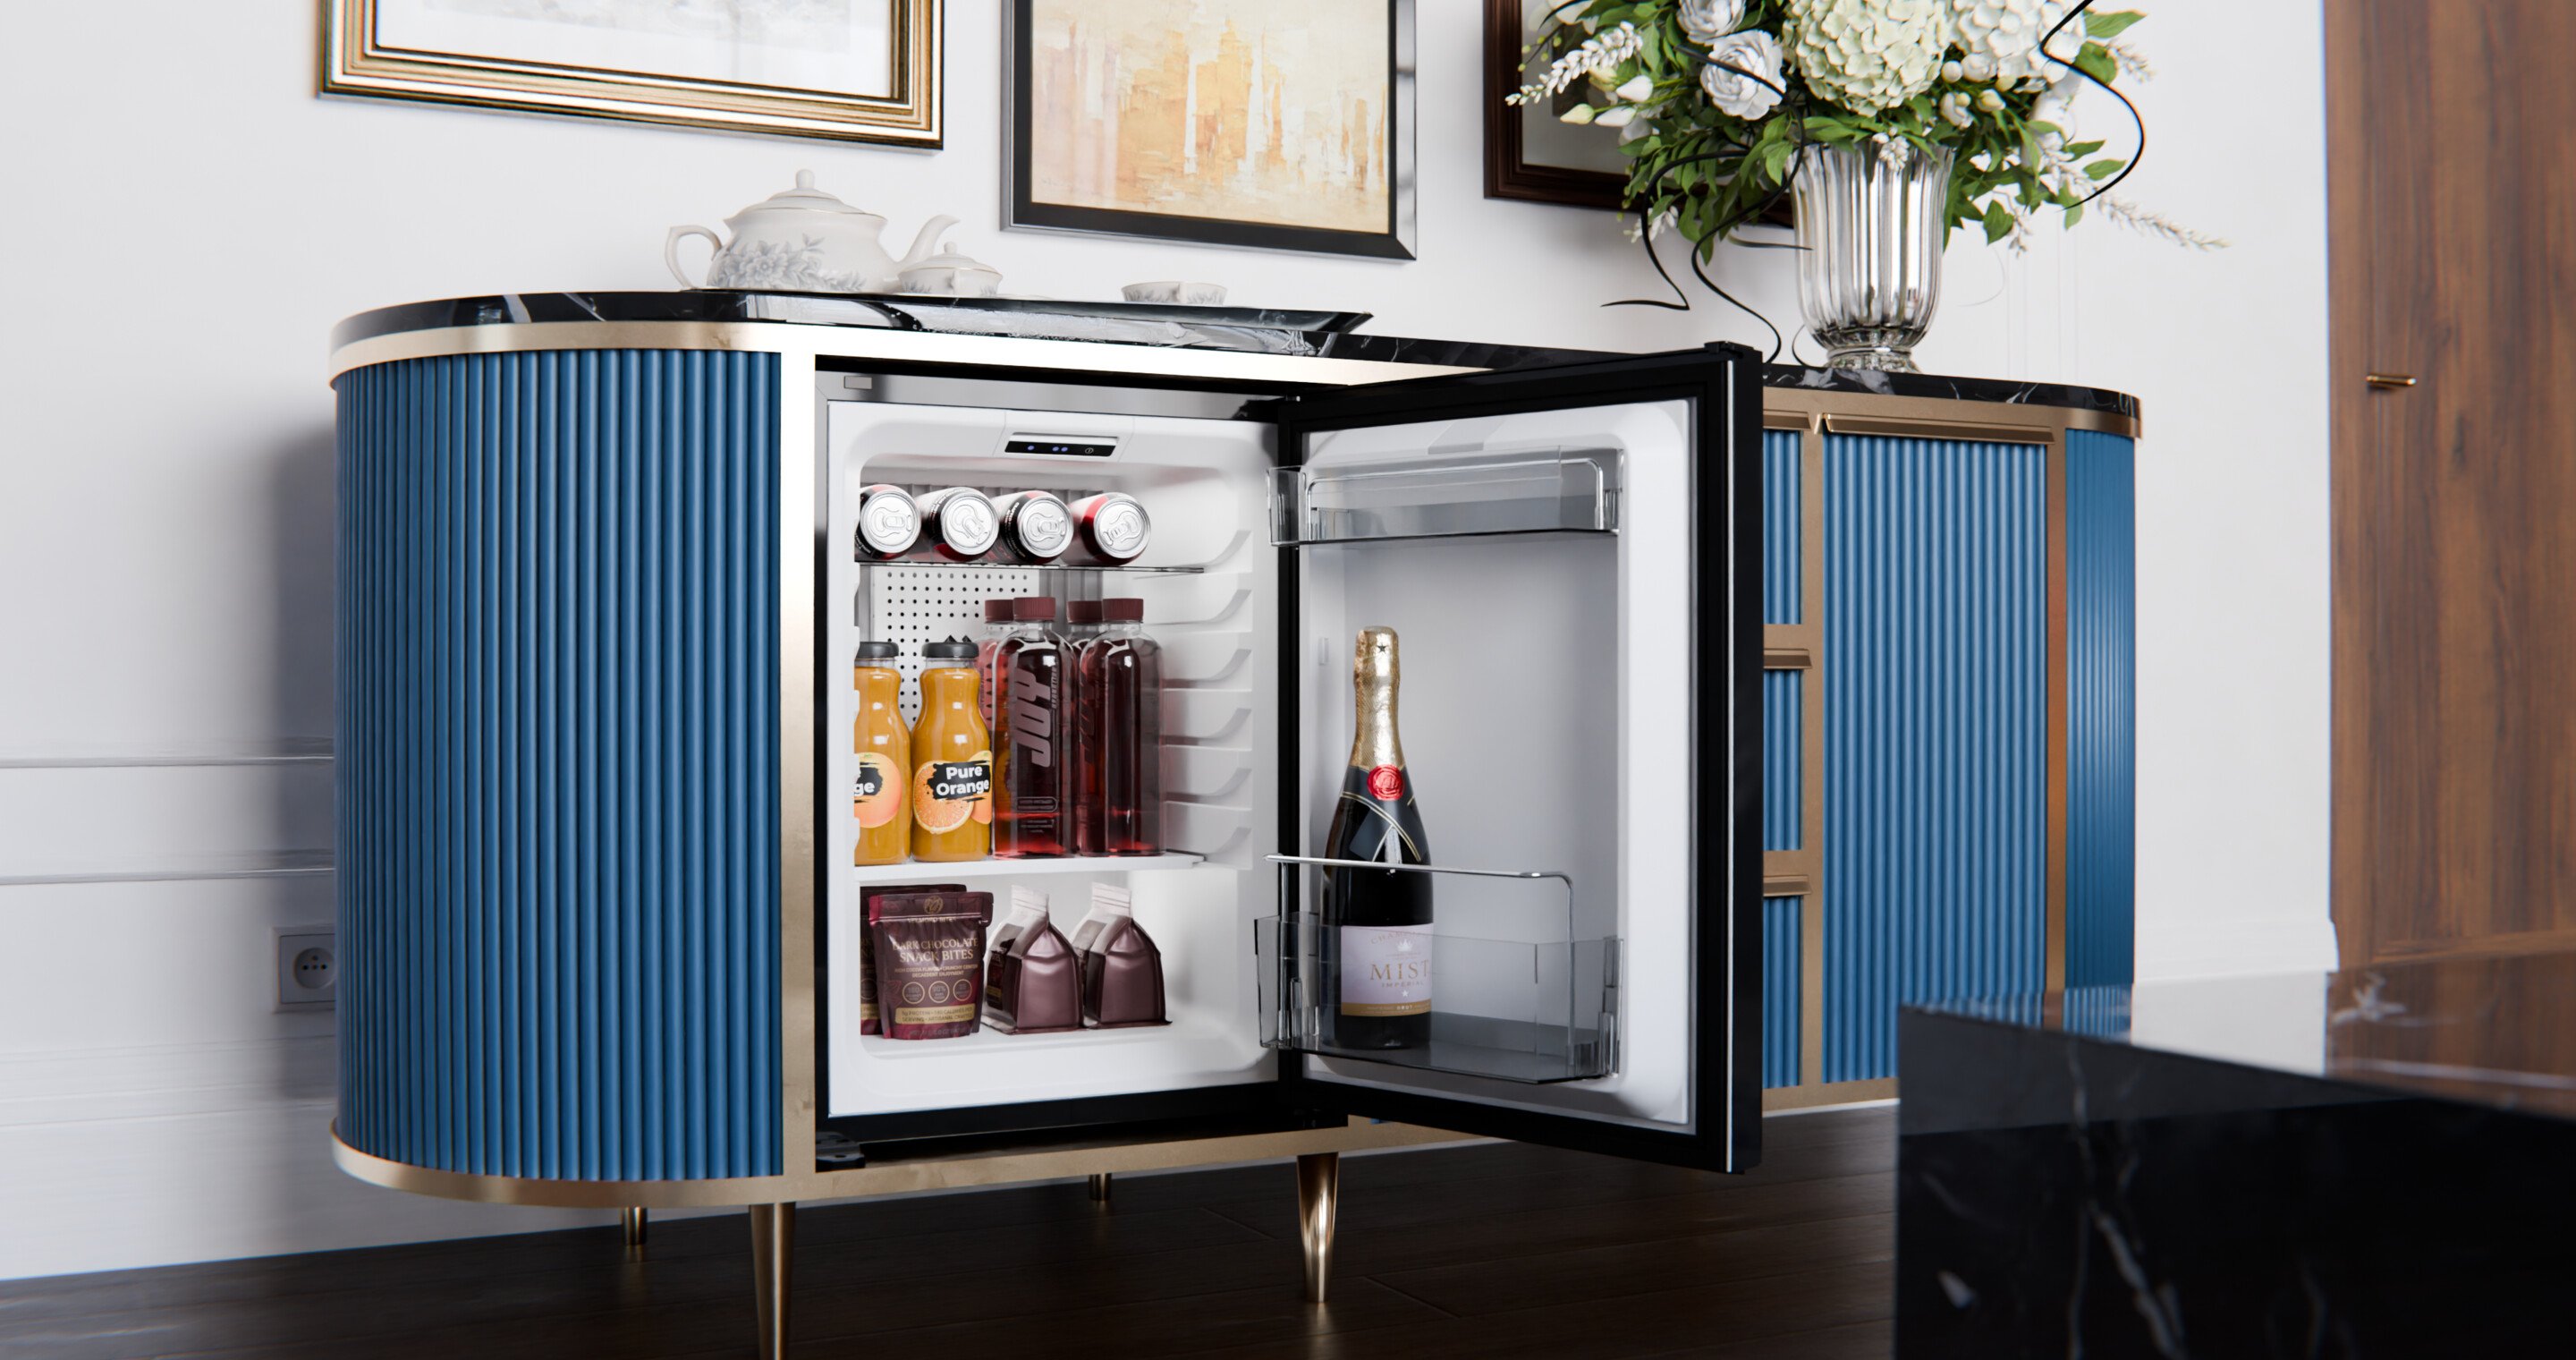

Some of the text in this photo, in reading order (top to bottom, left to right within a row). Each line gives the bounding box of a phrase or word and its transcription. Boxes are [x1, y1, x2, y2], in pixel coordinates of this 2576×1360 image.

[1013, 667, 1051, 768] JOY
[945, 766, 982, 780] Pure
[936, 779, 989, 796] Orange
[893, 938, 978, 950] DARK CHOCOLATE
[900, 948, 973, 963] SNACK BITES
[1369, 959, 1429, 981] MIST
